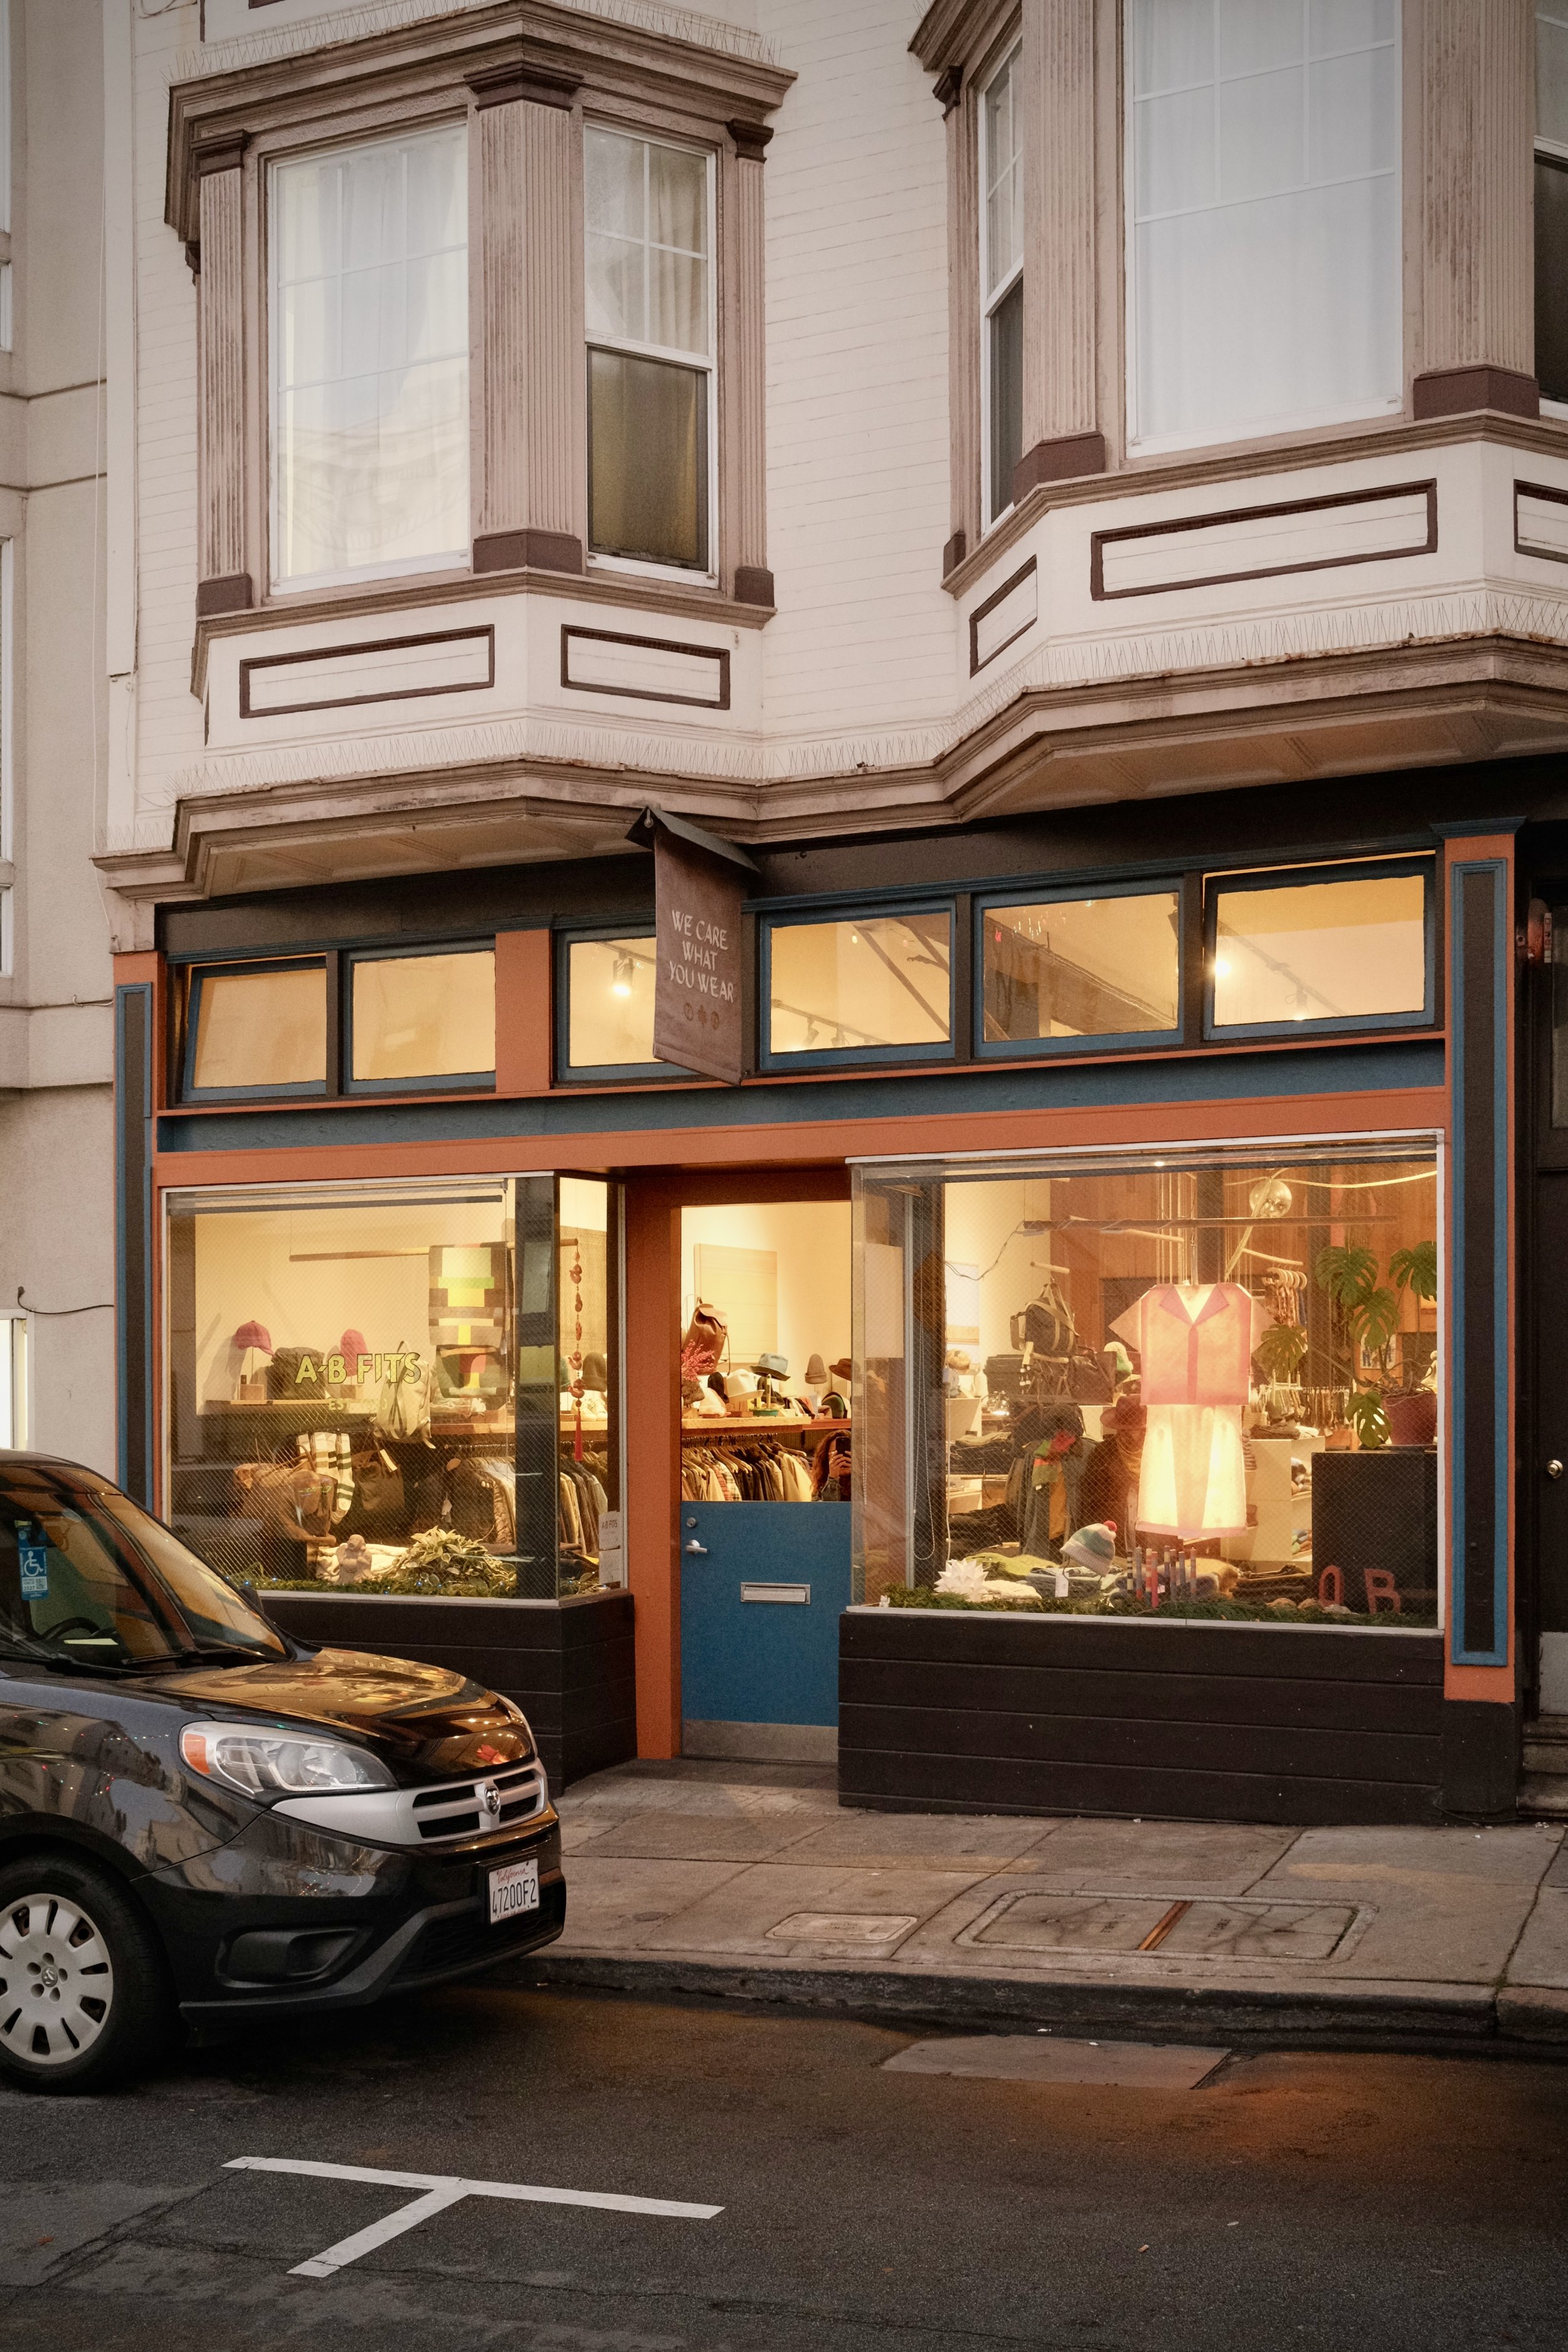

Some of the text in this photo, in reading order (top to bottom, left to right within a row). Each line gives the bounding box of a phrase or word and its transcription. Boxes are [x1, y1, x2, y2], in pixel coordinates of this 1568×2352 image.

[671, 909, 729, 951] WE CARE
[682, 940, 718, 972] WHAT
[669, 960, 734, 1003] YOU WEAR
[295, 1352, 421, 1384] A-B FITS
[497, 1867, 529, 1884] California
[492, 1878, 537, 1915] 47200F2
